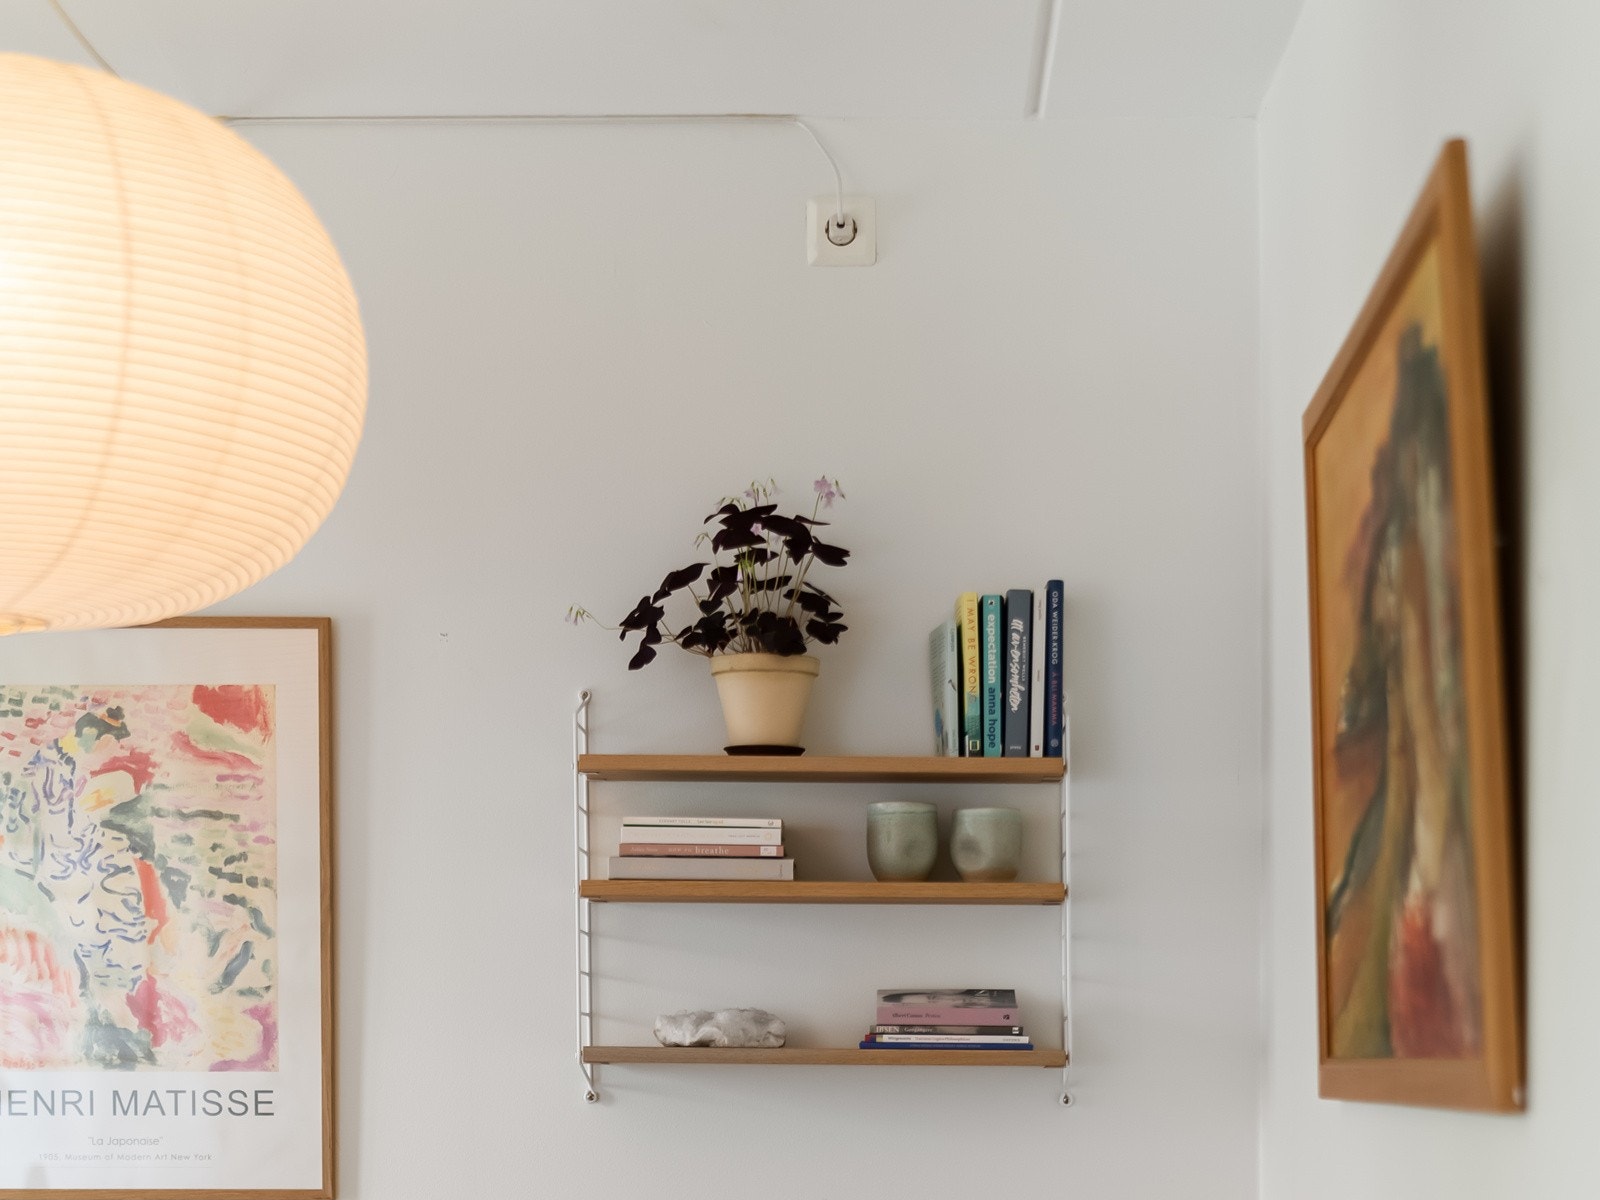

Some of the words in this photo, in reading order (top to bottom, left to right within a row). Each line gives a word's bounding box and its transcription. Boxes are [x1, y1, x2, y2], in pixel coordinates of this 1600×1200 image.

[967, 608, 976, 632] MAY
[968, 638, 976, 650] BE
[987, 614, 998, 684] expectation
[968, 656, 977, 704] WRONG
[988, 687, 997, 715] anna
[986, 719, 998, 749] hope
[695, 846, 729, 855] breathe
[0, 1090, 94, 1116] ENRI
[112, 1090, 275, 1116] MATISSE
[107, 1136, 163, 1148] Japonaise"
[65, 1153, 101, 1161] Museum
[105, 1153, 114, 1161] of
[117, 1153, 151, 1161] Modern
[154, 1153, 168, 1161] Art
[171, 1153, 190, 1161] New
[192, 1153, 212, 1161] York
